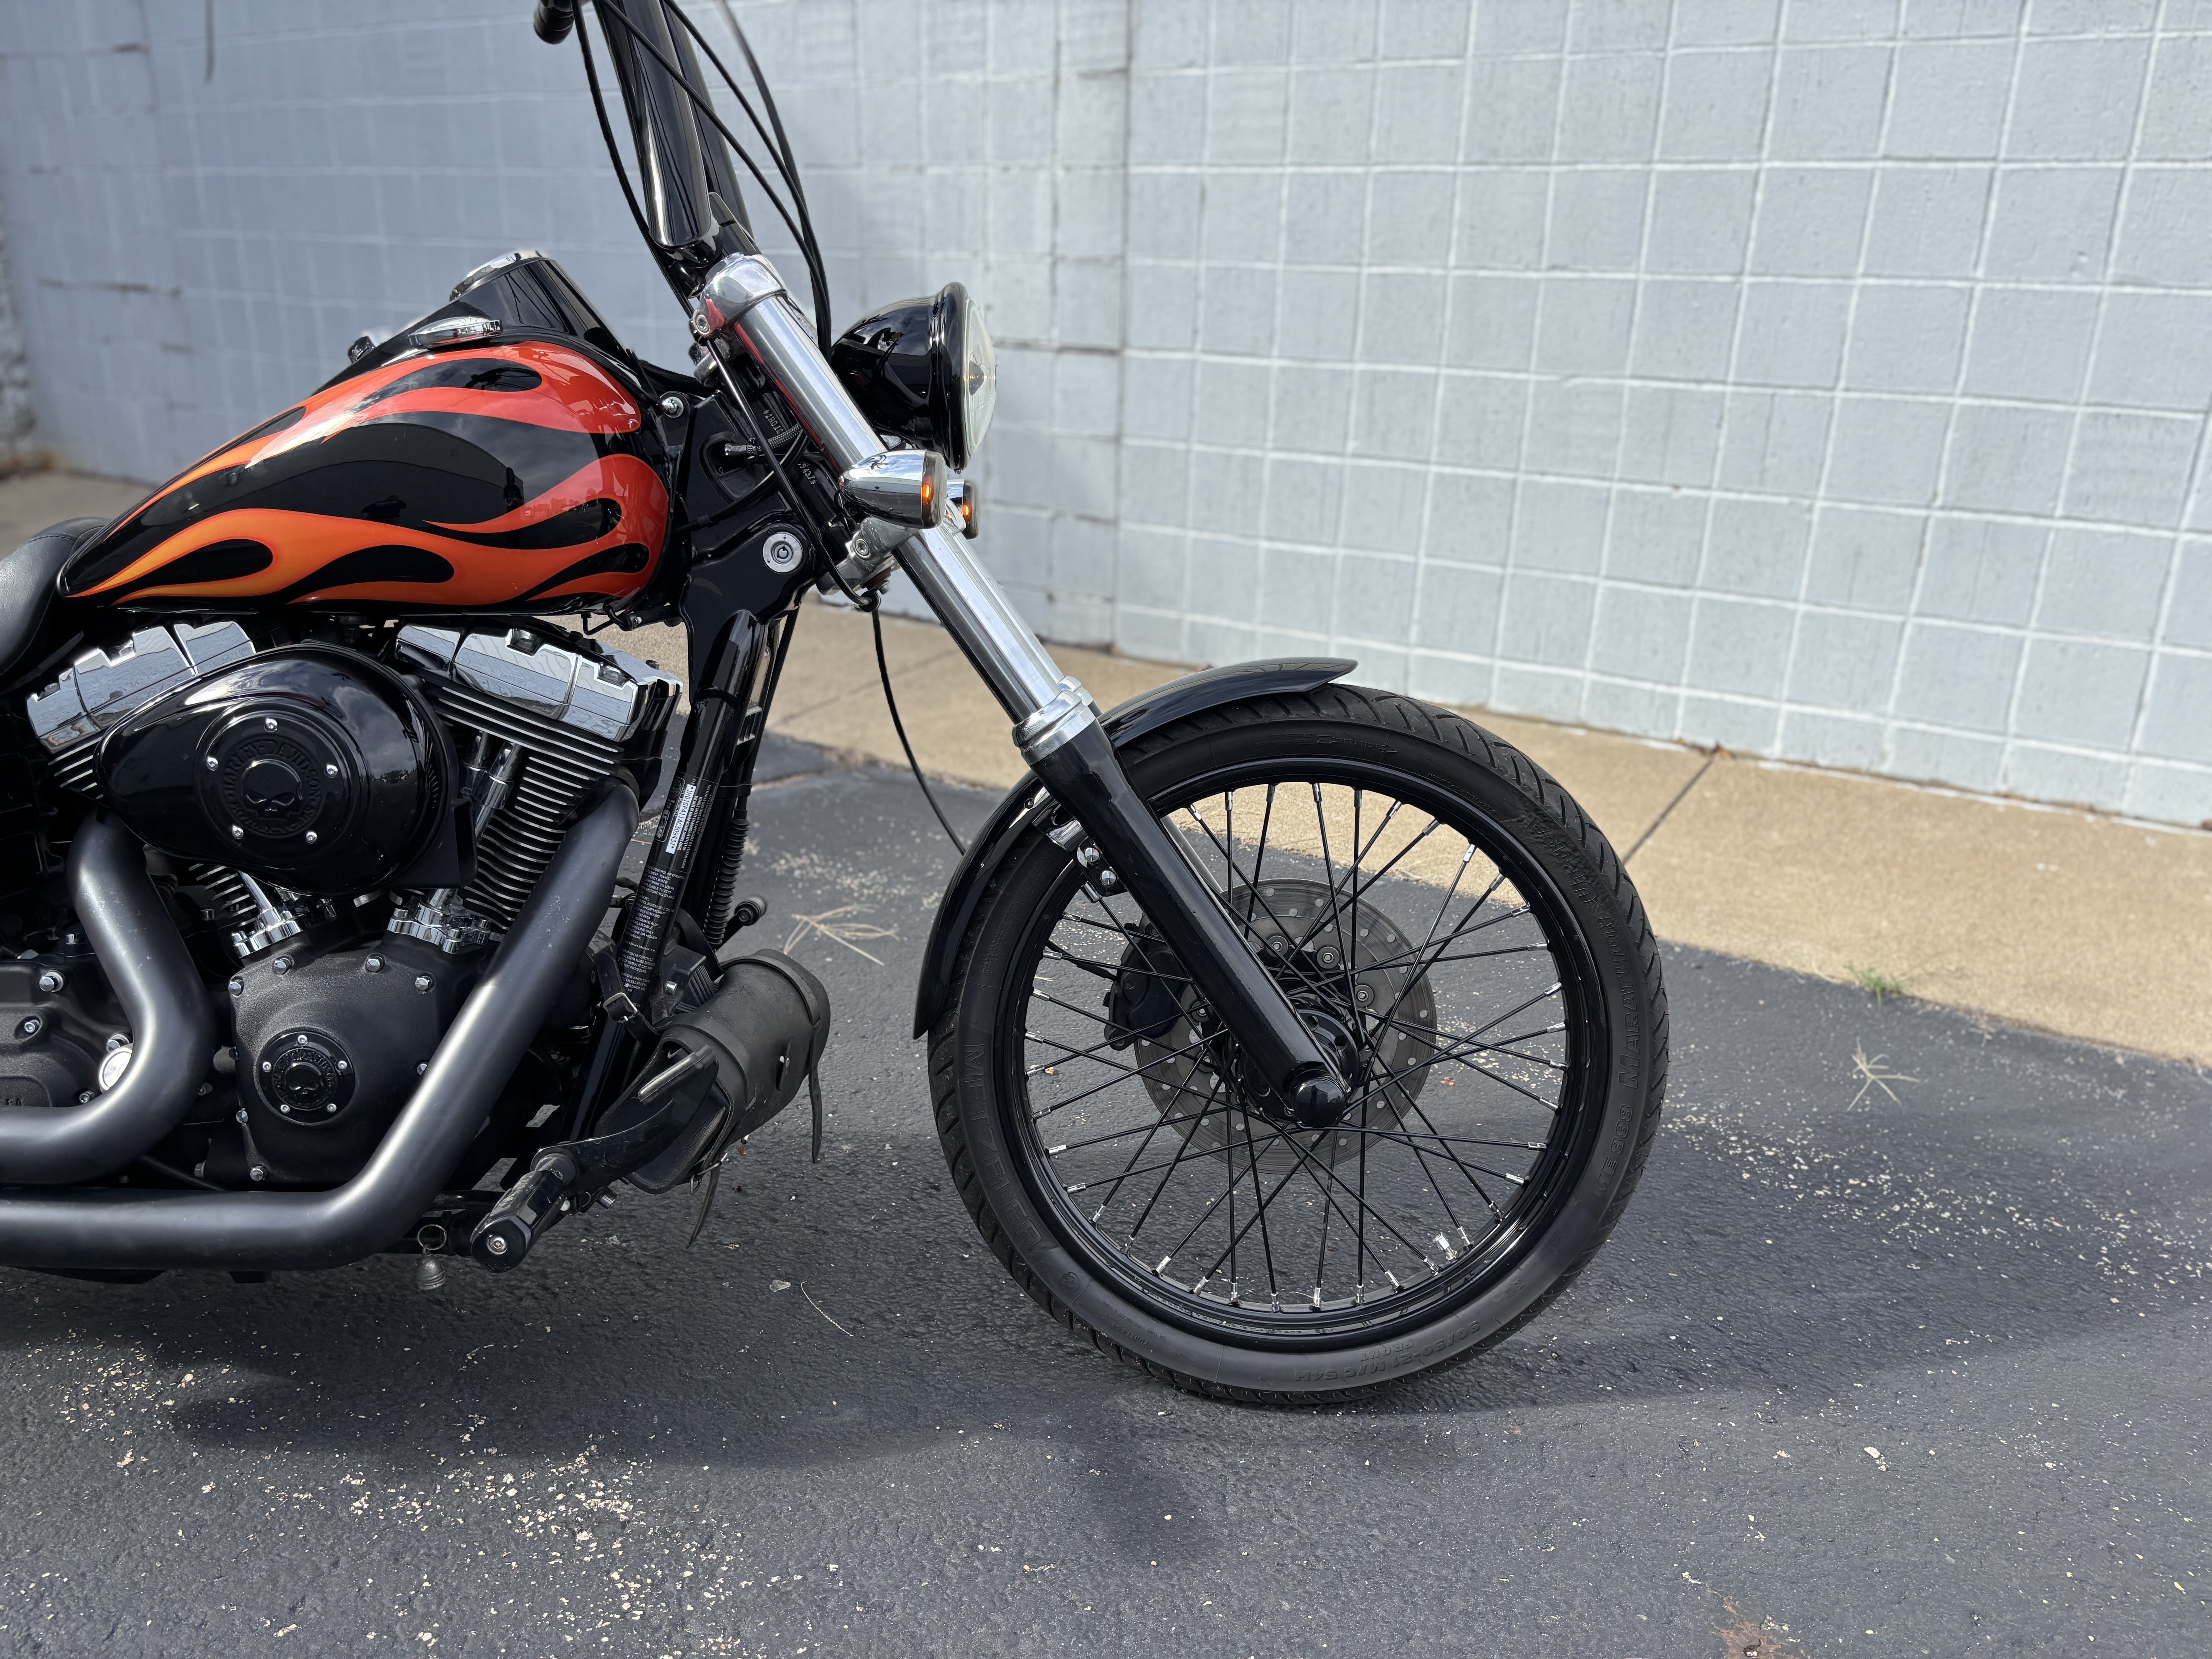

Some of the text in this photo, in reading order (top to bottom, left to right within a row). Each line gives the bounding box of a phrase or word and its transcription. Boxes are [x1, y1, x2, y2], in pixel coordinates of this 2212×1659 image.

[1528, 816, 1597, 904] ULTRA
[1597, 917, 1640, 1089] MARATHON
[964, 1043, 1042, 1247] METZELER
[1611, 1104, 1634, 1154] 888
[1295, 1369, 1337, 1382] 54H
[1359, 1338, 1415, 1362] FRONT
